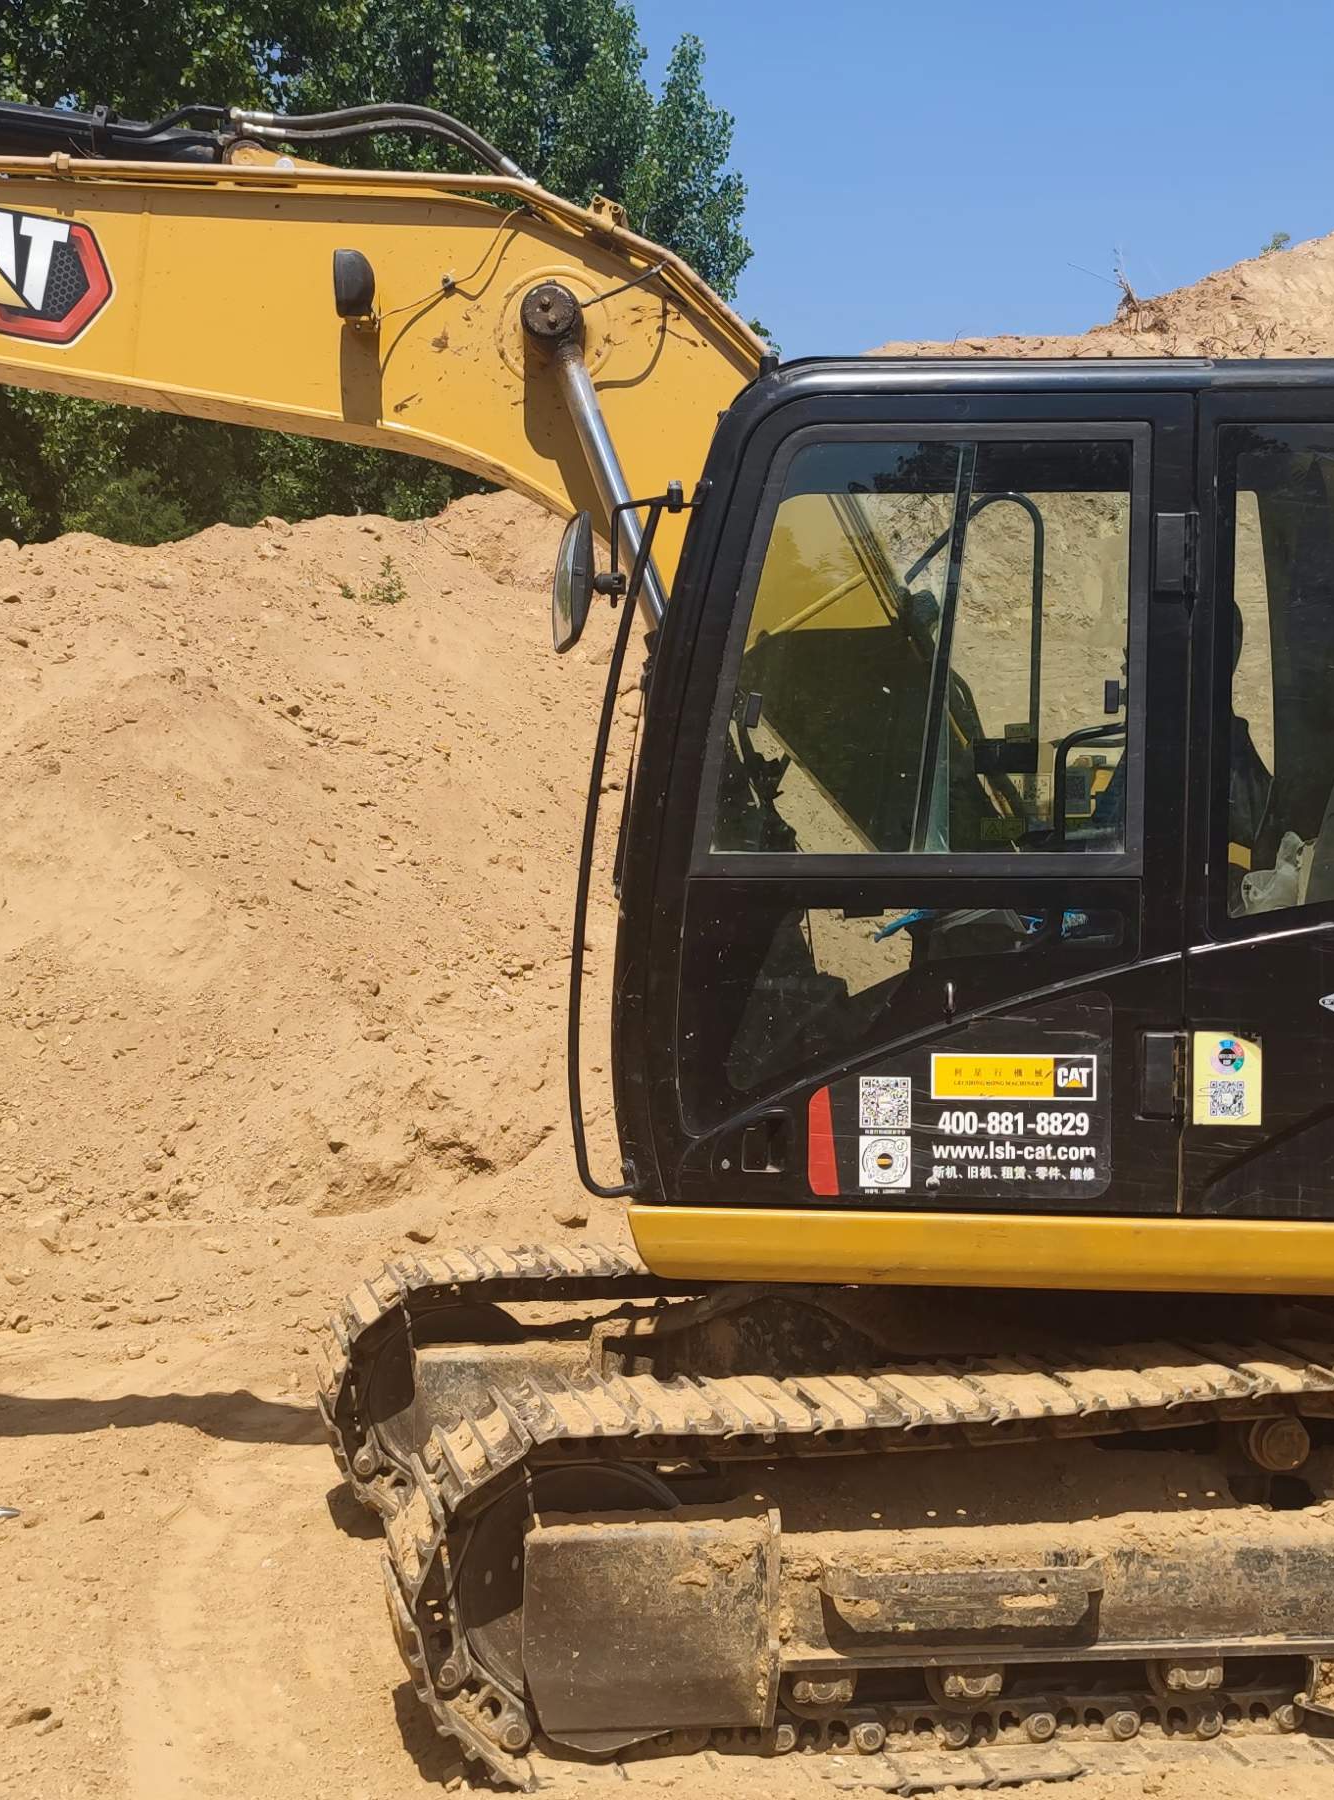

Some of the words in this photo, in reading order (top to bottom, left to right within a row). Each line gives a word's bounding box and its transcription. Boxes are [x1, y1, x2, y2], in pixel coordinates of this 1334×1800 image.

[1056, 1067, 1093, 1088] CAT
[938, 1111, 1090, 1136] 400-881-8829
[932, 1141, 1096, 1161] www.lsh-cat.com
